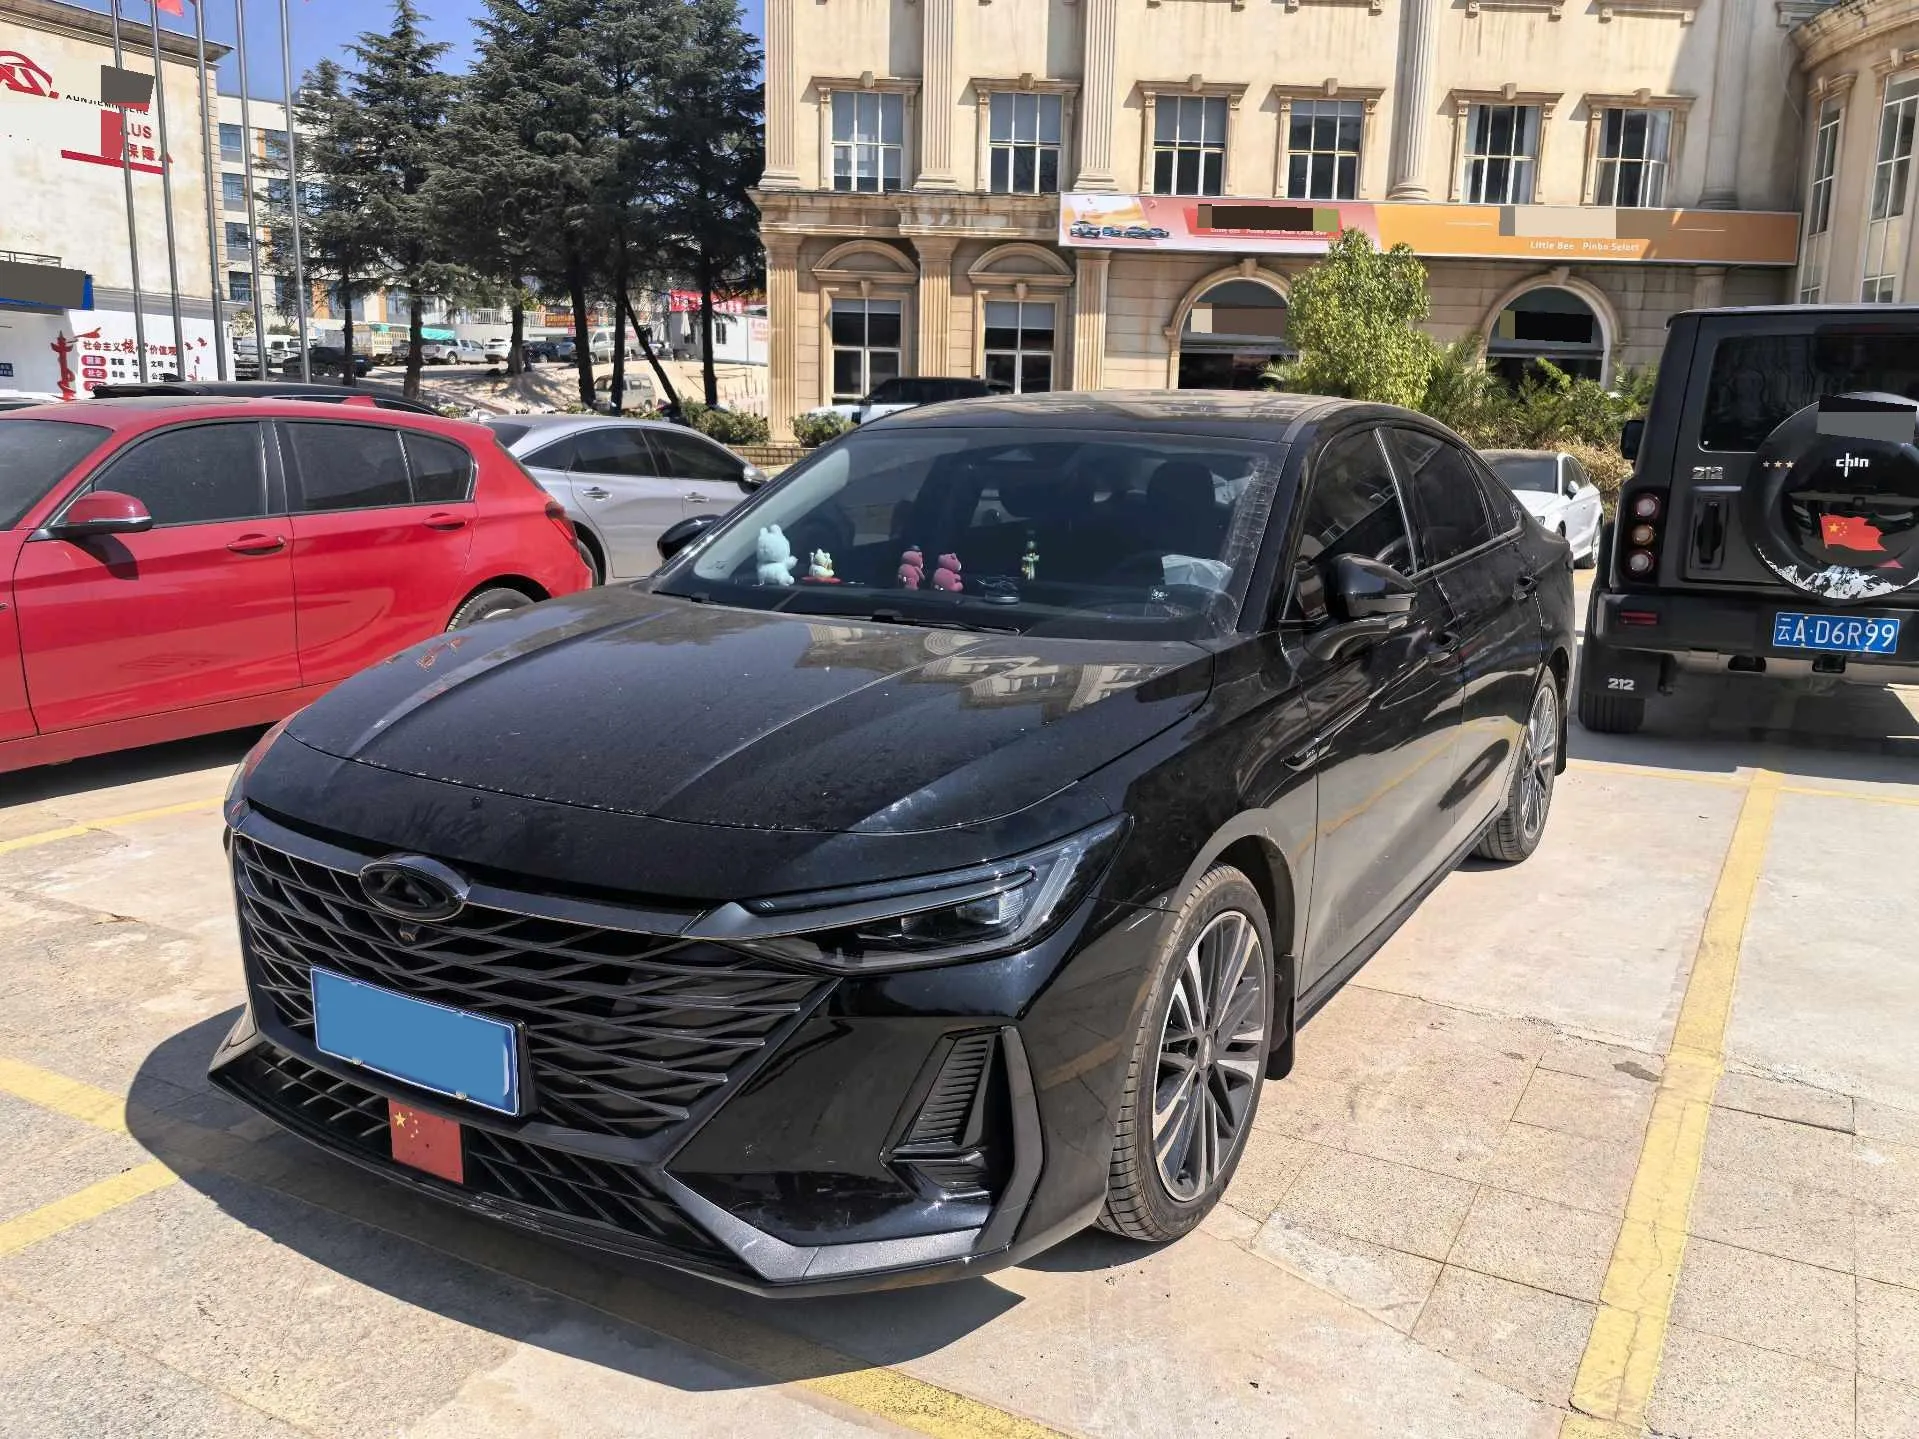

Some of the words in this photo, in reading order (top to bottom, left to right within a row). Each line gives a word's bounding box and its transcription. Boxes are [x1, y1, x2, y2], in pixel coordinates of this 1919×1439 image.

[1530, 241, 1554, 250] Little
[1557, 241, 1575, 250] Bee
[1692, 466, 1724, 480] 212
[1607, 677, 1635, 692] 212
